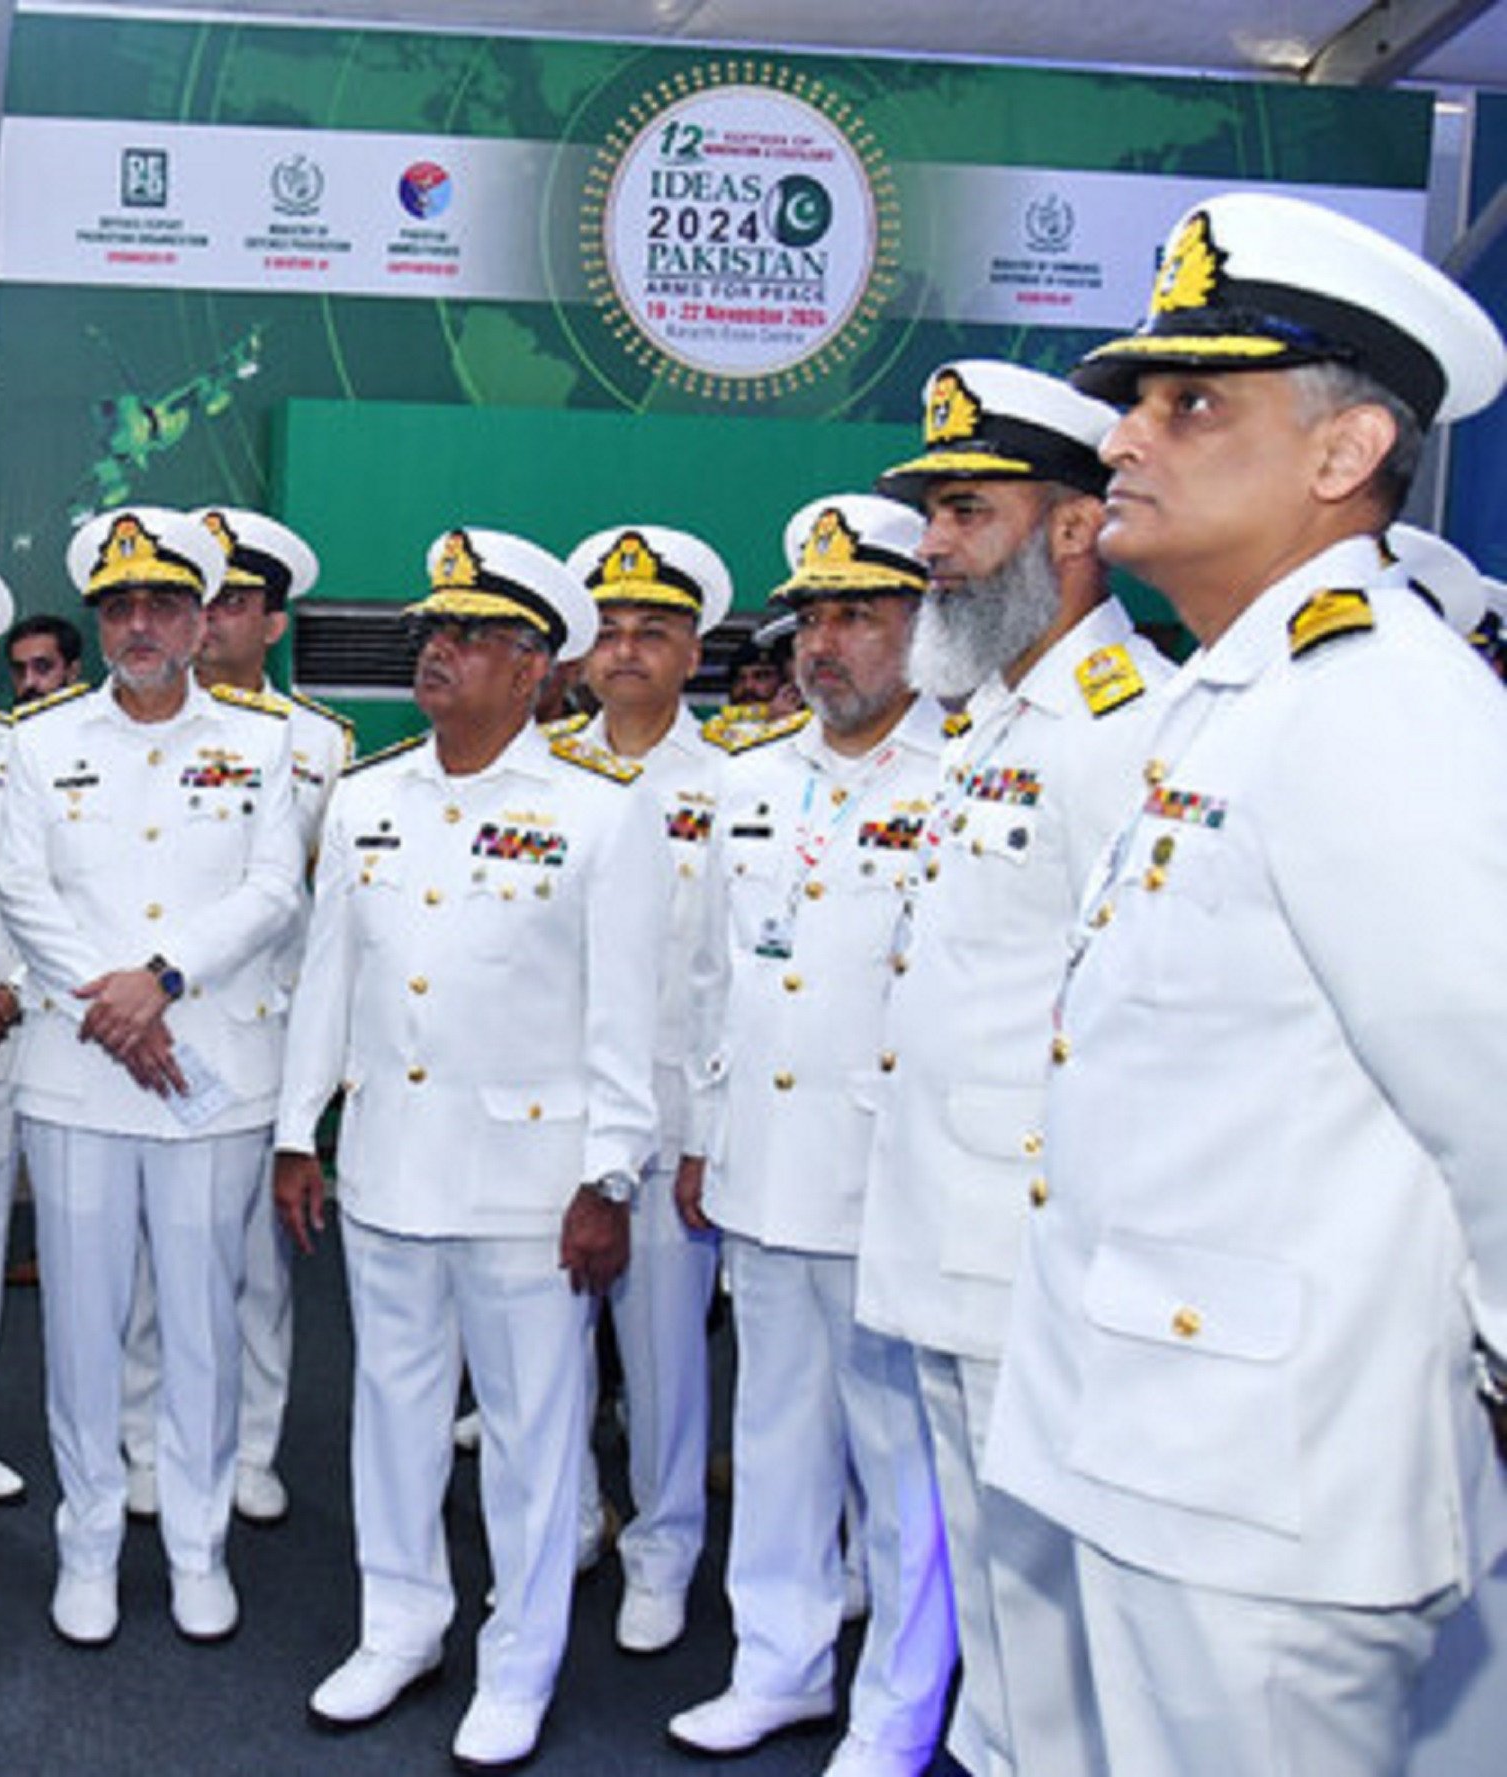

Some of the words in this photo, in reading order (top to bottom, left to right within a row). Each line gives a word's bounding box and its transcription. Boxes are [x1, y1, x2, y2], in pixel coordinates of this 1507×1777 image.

[651, 170, 762, 202] IDEAS
[647, 205, 760, 243] 2024
[646, 243, 828, 276] PAKISTAN
[645, 281, 703, 297] ARMS
[710, 283, 752, 299] FOR
